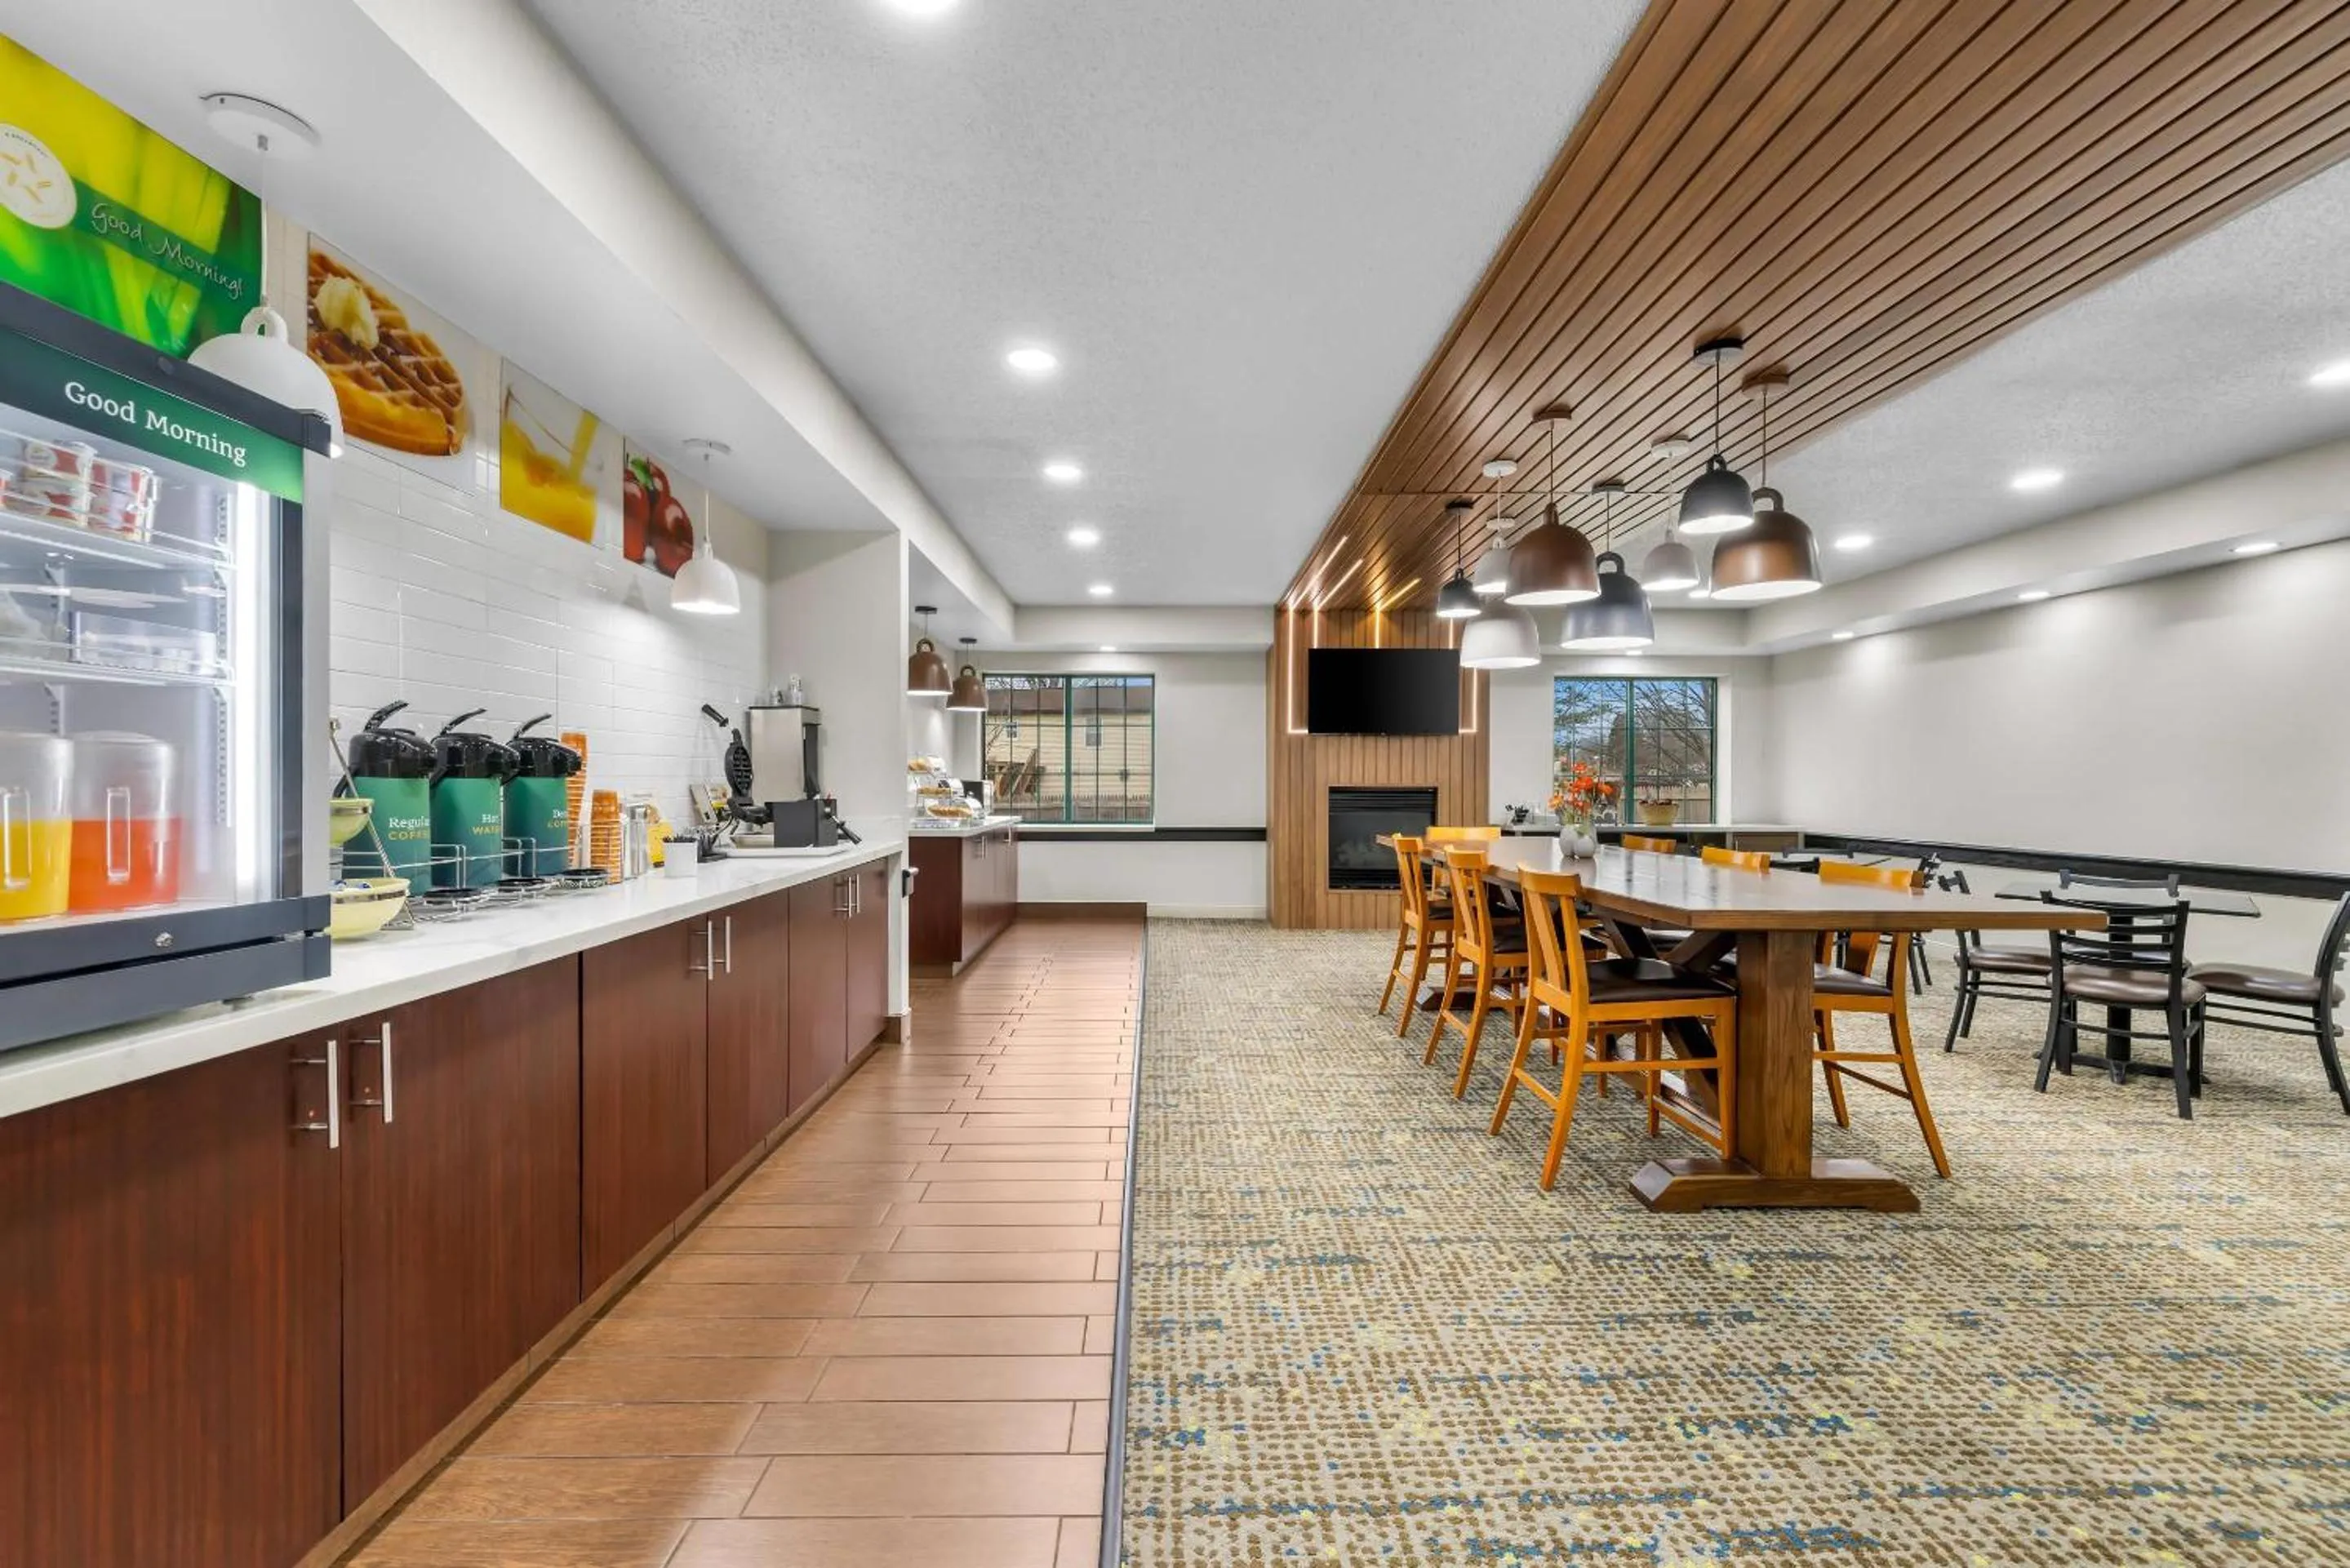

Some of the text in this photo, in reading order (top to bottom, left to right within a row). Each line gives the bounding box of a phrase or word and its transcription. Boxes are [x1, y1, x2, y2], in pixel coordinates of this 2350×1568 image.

[91, 203, 242, 300] Good Morning!
[65, 382, 247, 467] Good Morning
[389, 815, 430, 830] Regula
